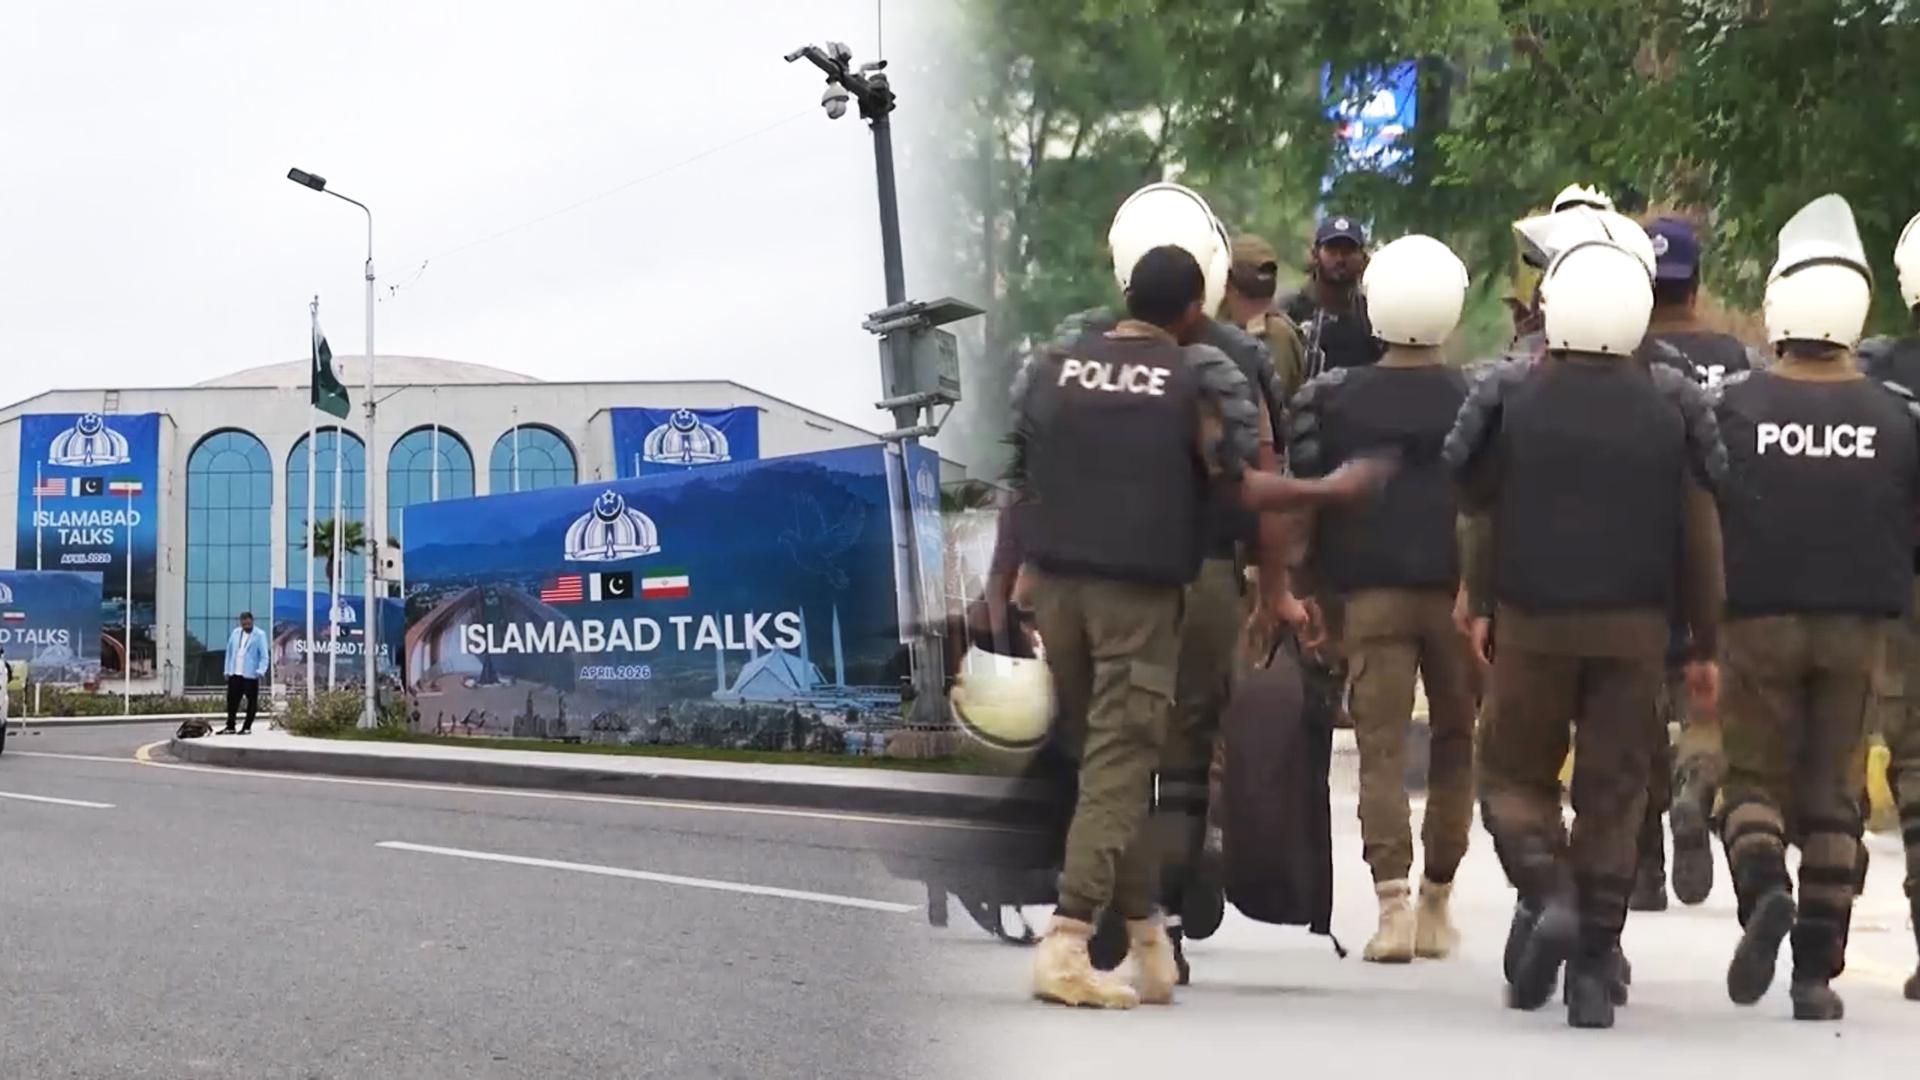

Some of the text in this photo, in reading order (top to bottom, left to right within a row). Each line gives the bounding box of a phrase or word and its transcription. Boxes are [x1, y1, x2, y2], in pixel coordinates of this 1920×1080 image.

[1057, 358, 1171, 396] POLICE
[1757, 422, 1877, 458] POLICE
[33, 510, 141, 527] ISLAMABAD
[57, 528, 114, 545] TALKS
[60, 553, 86, 564] APRIL
[14, 628, 69, 644] TALKS
[460, 611, 801, 655] ISLAMABAD TALKS
[579, 665, 651, 681] APRIL 2026
